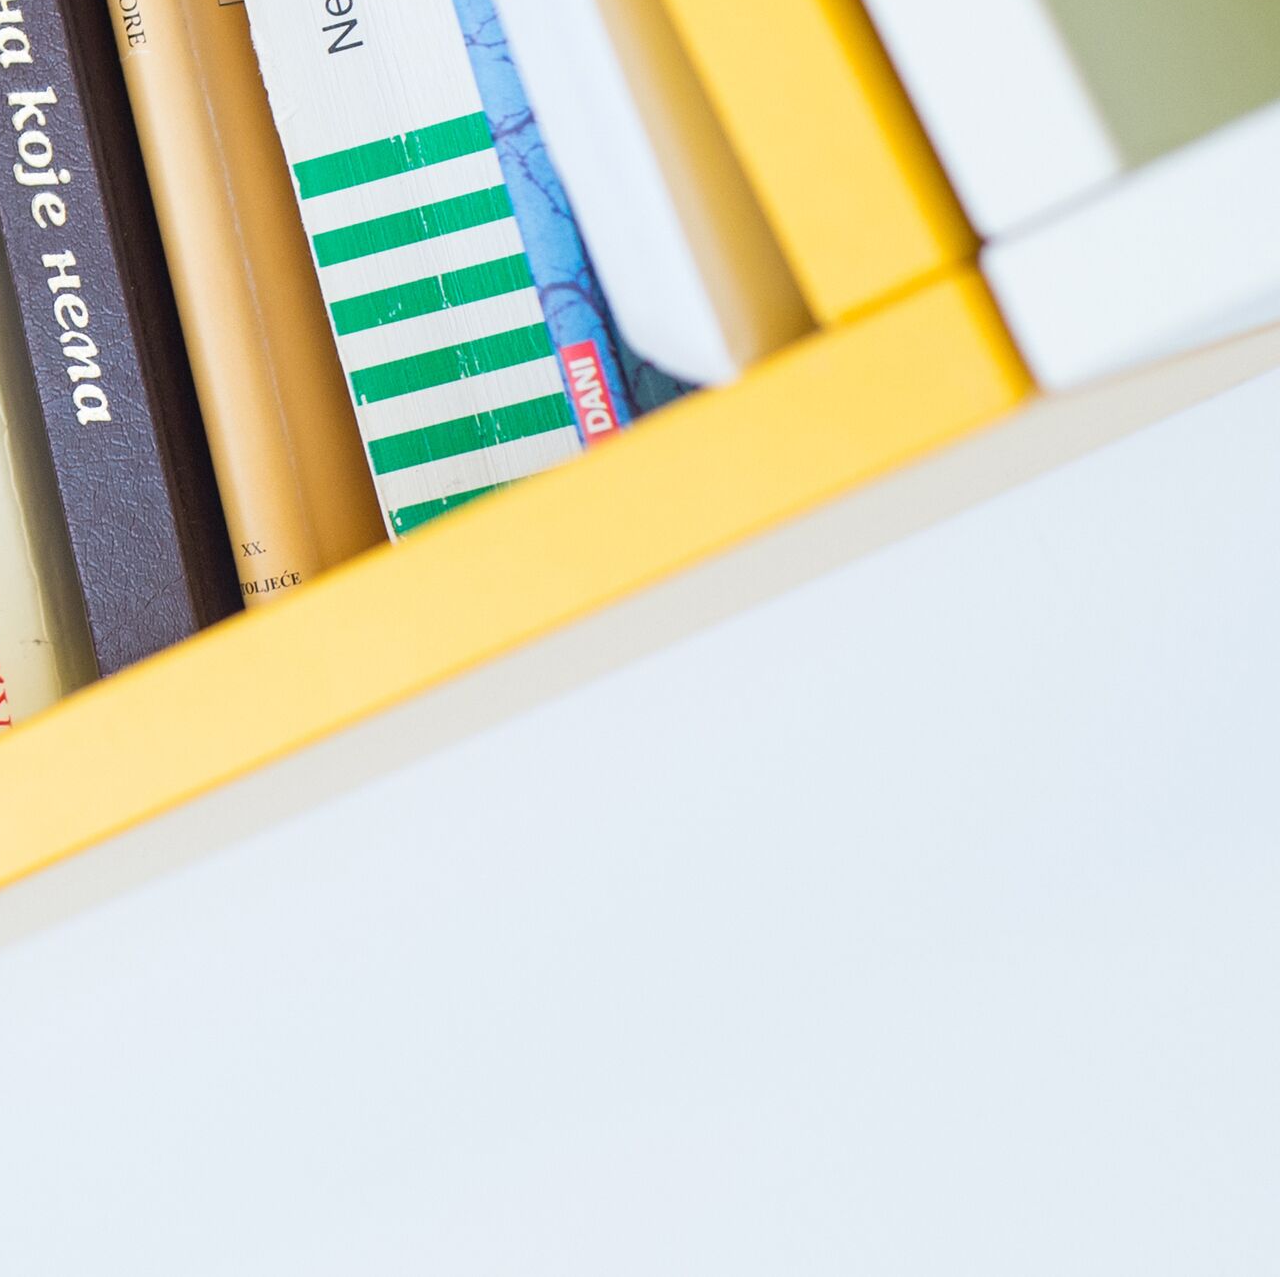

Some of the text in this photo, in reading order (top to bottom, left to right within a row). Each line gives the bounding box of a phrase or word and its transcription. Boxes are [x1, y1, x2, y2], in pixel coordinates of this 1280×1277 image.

[7, 85, 71, 228] које
[42, 249, 112, 426] нема
[569, 356, 613, 436] DANI
[240, 541, 267, 558] XX.
[240, 570, 302, 596] TOLJEĆE
